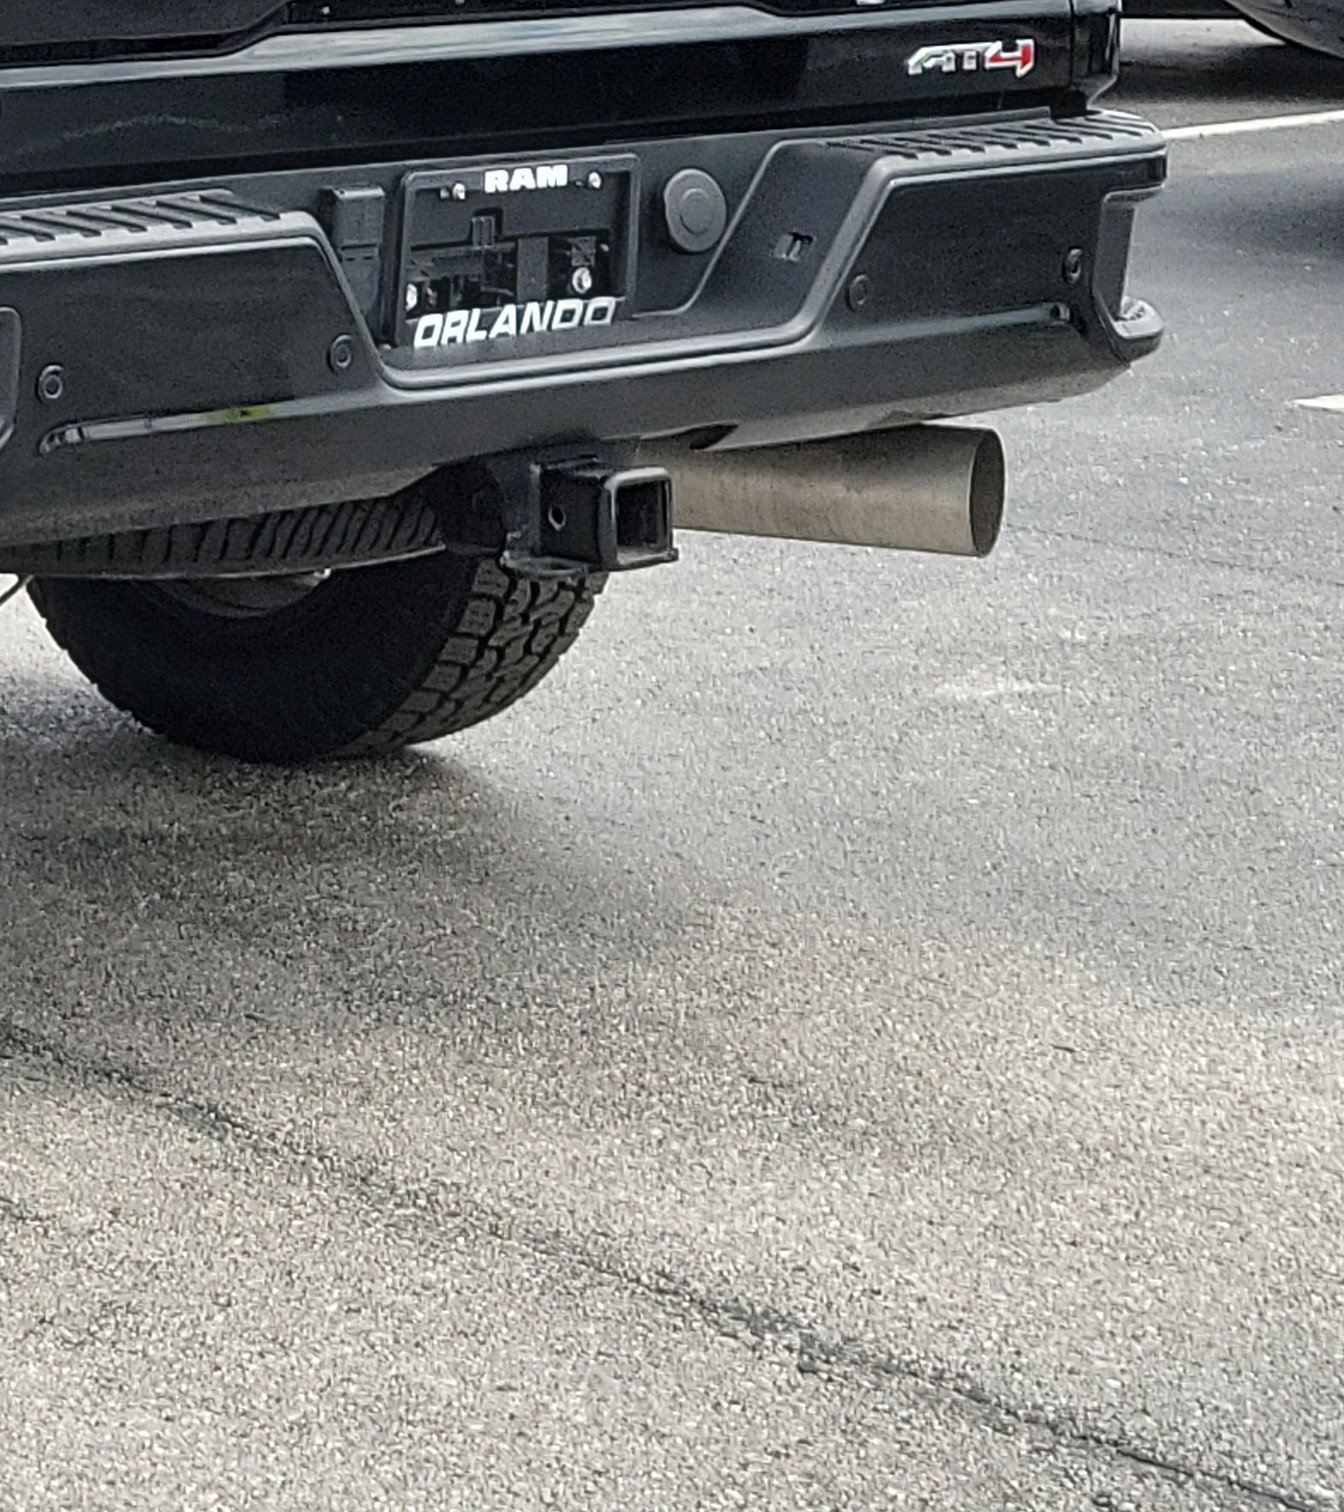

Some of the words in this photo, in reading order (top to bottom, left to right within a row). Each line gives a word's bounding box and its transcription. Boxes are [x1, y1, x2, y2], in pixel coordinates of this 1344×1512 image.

[907, 38, 1035, 78] AT4
[484, 164, 568, 193] RAM
[414, 296, 617, 349] ORLANDO
